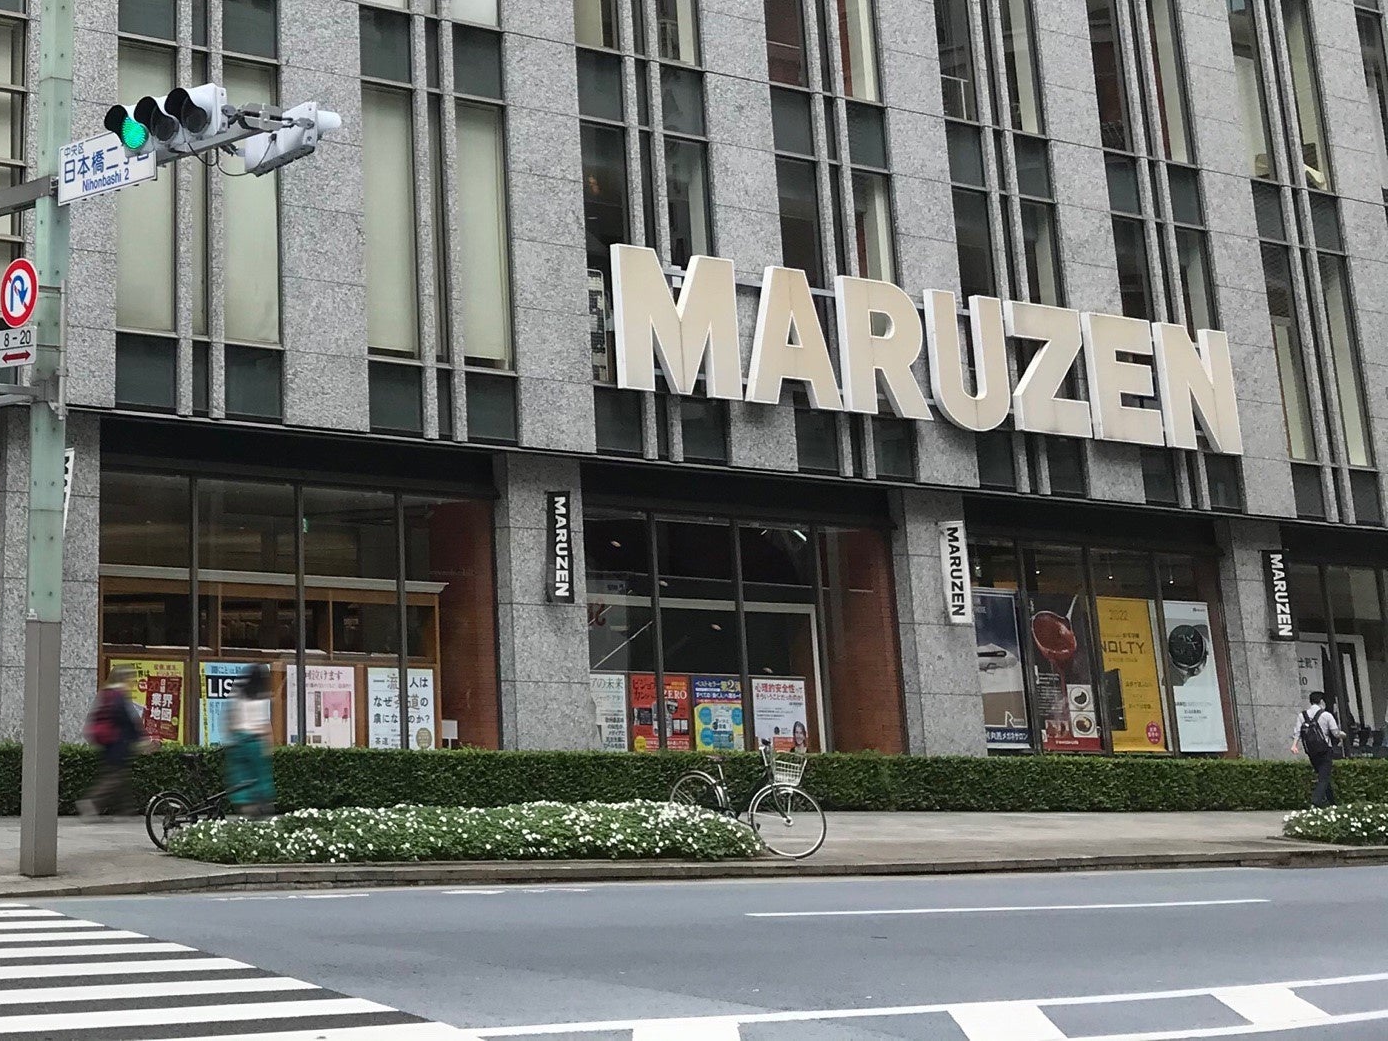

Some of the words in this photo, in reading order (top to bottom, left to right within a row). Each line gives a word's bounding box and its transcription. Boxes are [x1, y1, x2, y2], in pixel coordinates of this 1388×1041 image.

[64, 142, 84, 158] 中央区
[82, 169, 122, 192] Nihonbashi
[124, 168, 130, 180] 2
[610, 243, 1243, 456] MARUZEN
[553, 496, 570, 598] MARUZEN
[945, 527, 966, 617] MARUZEN
[1270, 553, 1293, 637] MARUZEN
[373, 673, 429, 690] 一流人は
